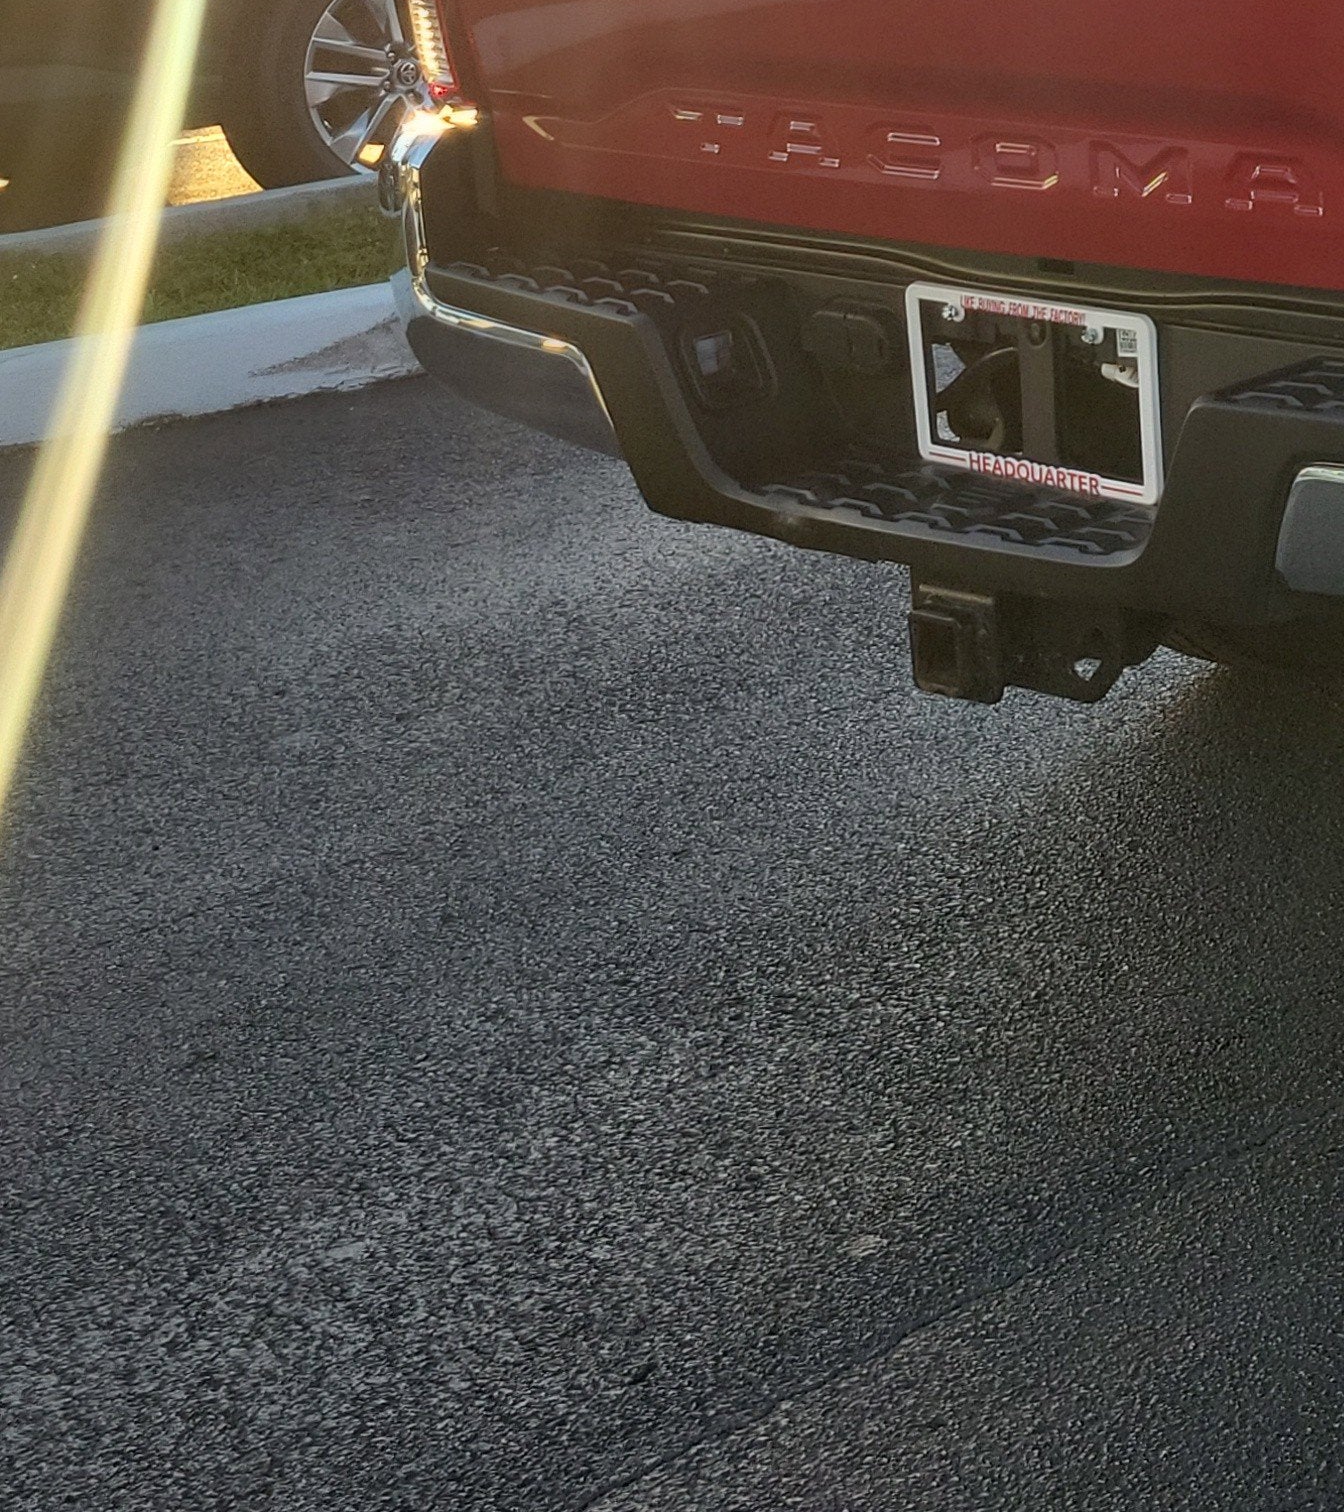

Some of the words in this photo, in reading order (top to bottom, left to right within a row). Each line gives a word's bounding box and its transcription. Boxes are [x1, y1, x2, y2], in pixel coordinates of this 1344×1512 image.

[666, 102, 1324, 216] TACOMA
[960, 293, 975, 309] LIKE
[978, 296, 1006, 315] BUYING
[1009, 301, 1029, 318] FROM
[1033, 305, 1048, 320] THE
[968, 452, 1100, 496] HEADQUARTER
